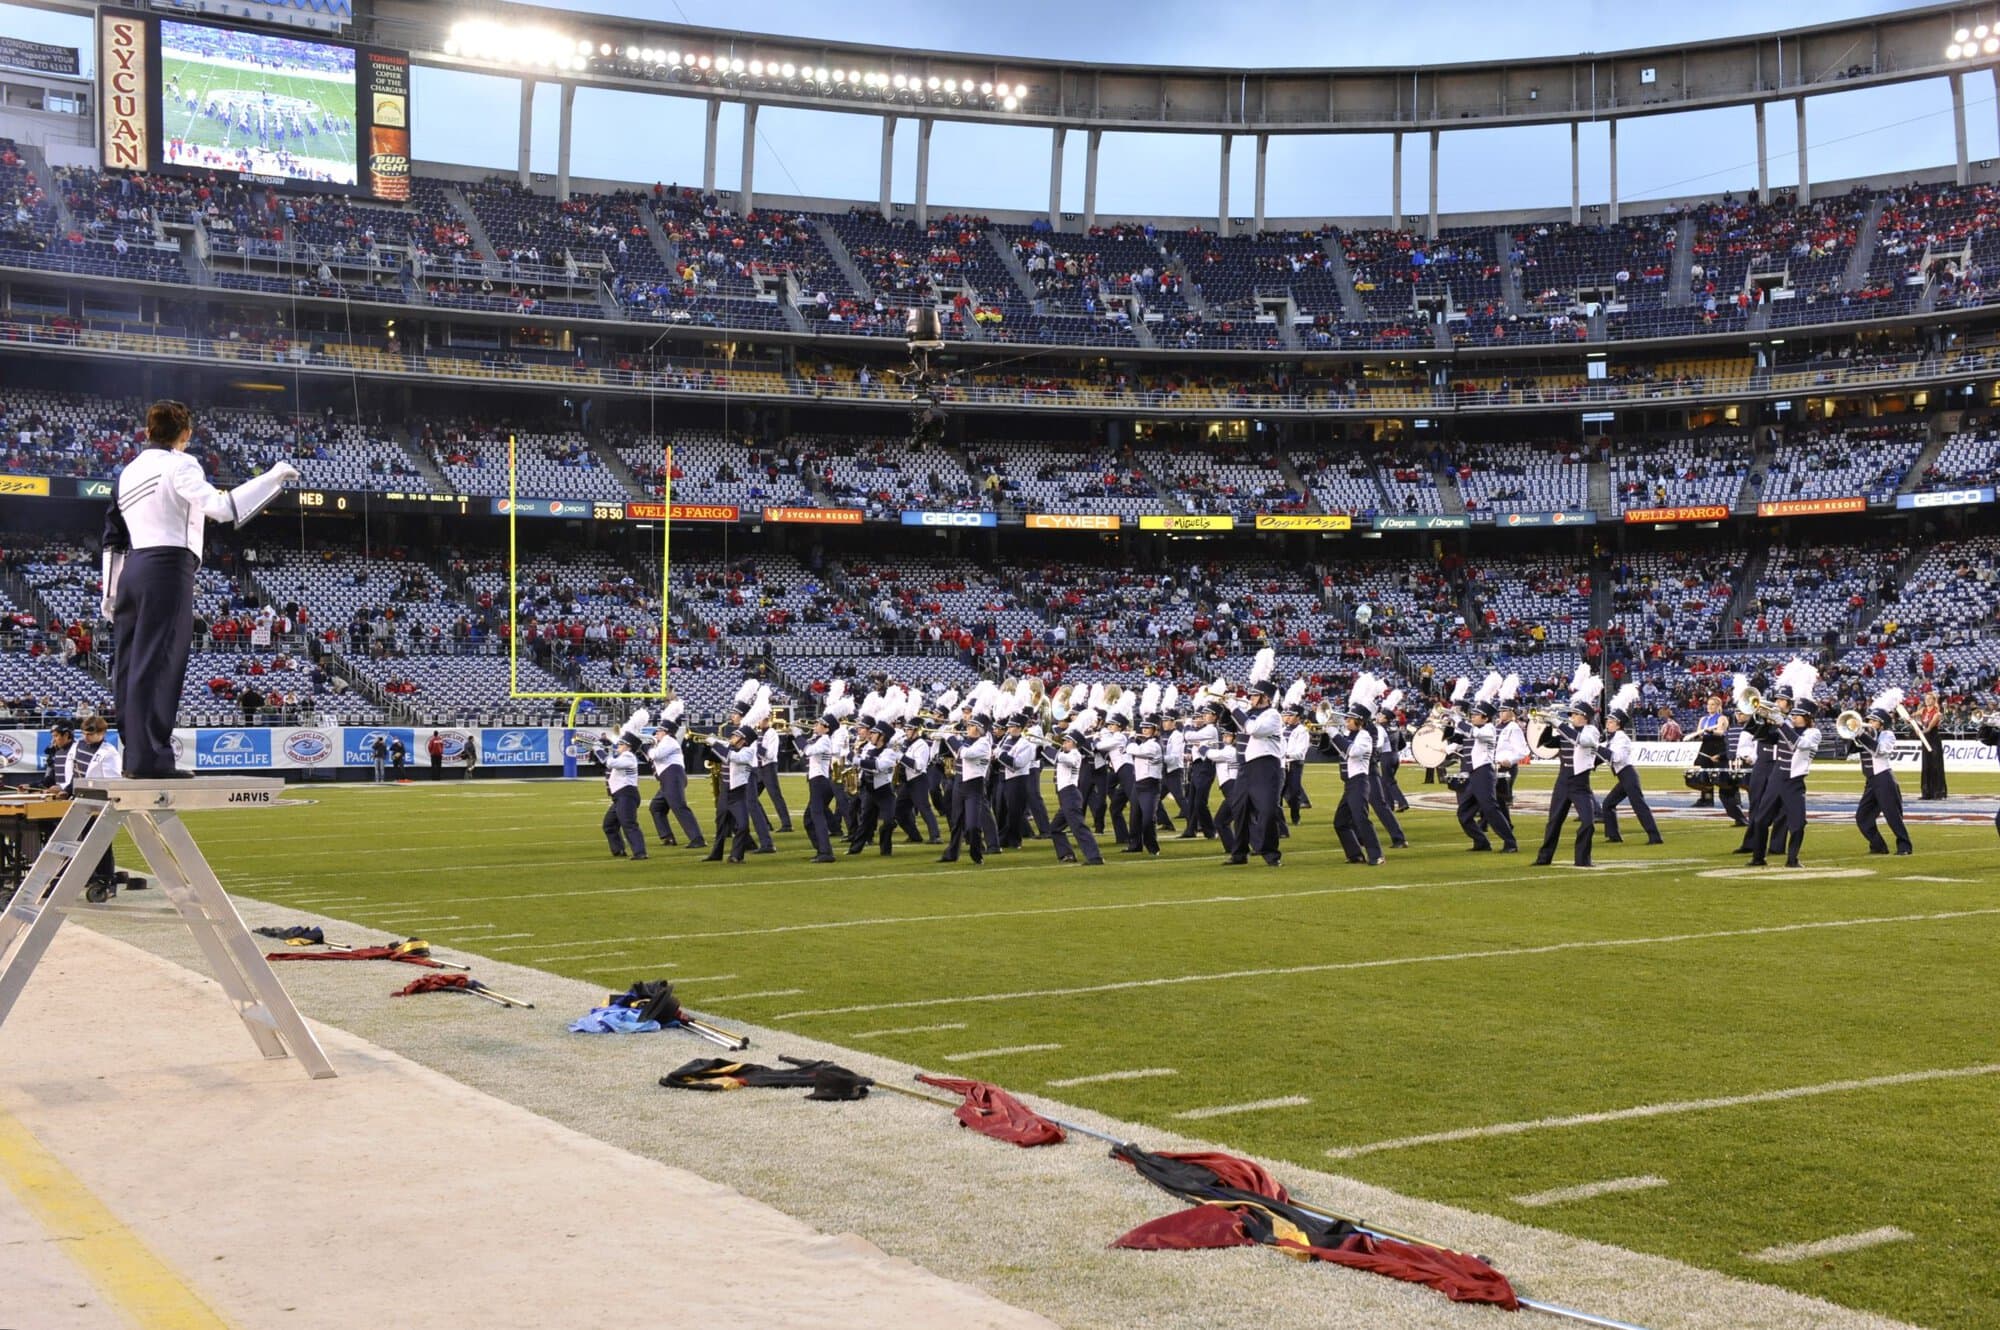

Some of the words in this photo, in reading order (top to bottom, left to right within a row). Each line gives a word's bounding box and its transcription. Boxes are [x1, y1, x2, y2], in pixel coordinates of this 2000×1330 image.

[113, 24, 138, 166] SYCUAN
[370, 84, 408, 95] CHARGERS
[375, 155, 407, 164] BUD
[371, 162, 410, 172] LIGHT
[338, 497, 346, 510] 0
[1913, 490, 1982, 508] GEICO
[564, 505, 586, 513] pepsi
[685, 506, 733, 518] FARGO
[1782, 503, 1820, 512] SYCUAN
[1825, 500, 1863, 509] RESORT
[786, 511, 822, 519] SYCUAN
[826, 512, 860, 521] RESORT
[922, 512, 982, 526] GEICO
[1627, 508, 1676, 521] WELLS
[1678, 506, 1727, 520] FARGO
[1035, 517, 1110, 529] CYMER
[1388, 519, 1417, 528] Degree
[1435, 518, 1464, 528] Degree
[198, 753, 244, 765] PACIFIC
[244, 752, 269, 764] LIFE
[484, 752, 524, 762] PACIFIC
[524, 751, 547, 762] LIFE
[1637, 747, 1676, 762] PACIFIC
[1943, 745, 1986, 761] PACIFIC
[227, 792, 270, 803] JARVIS
